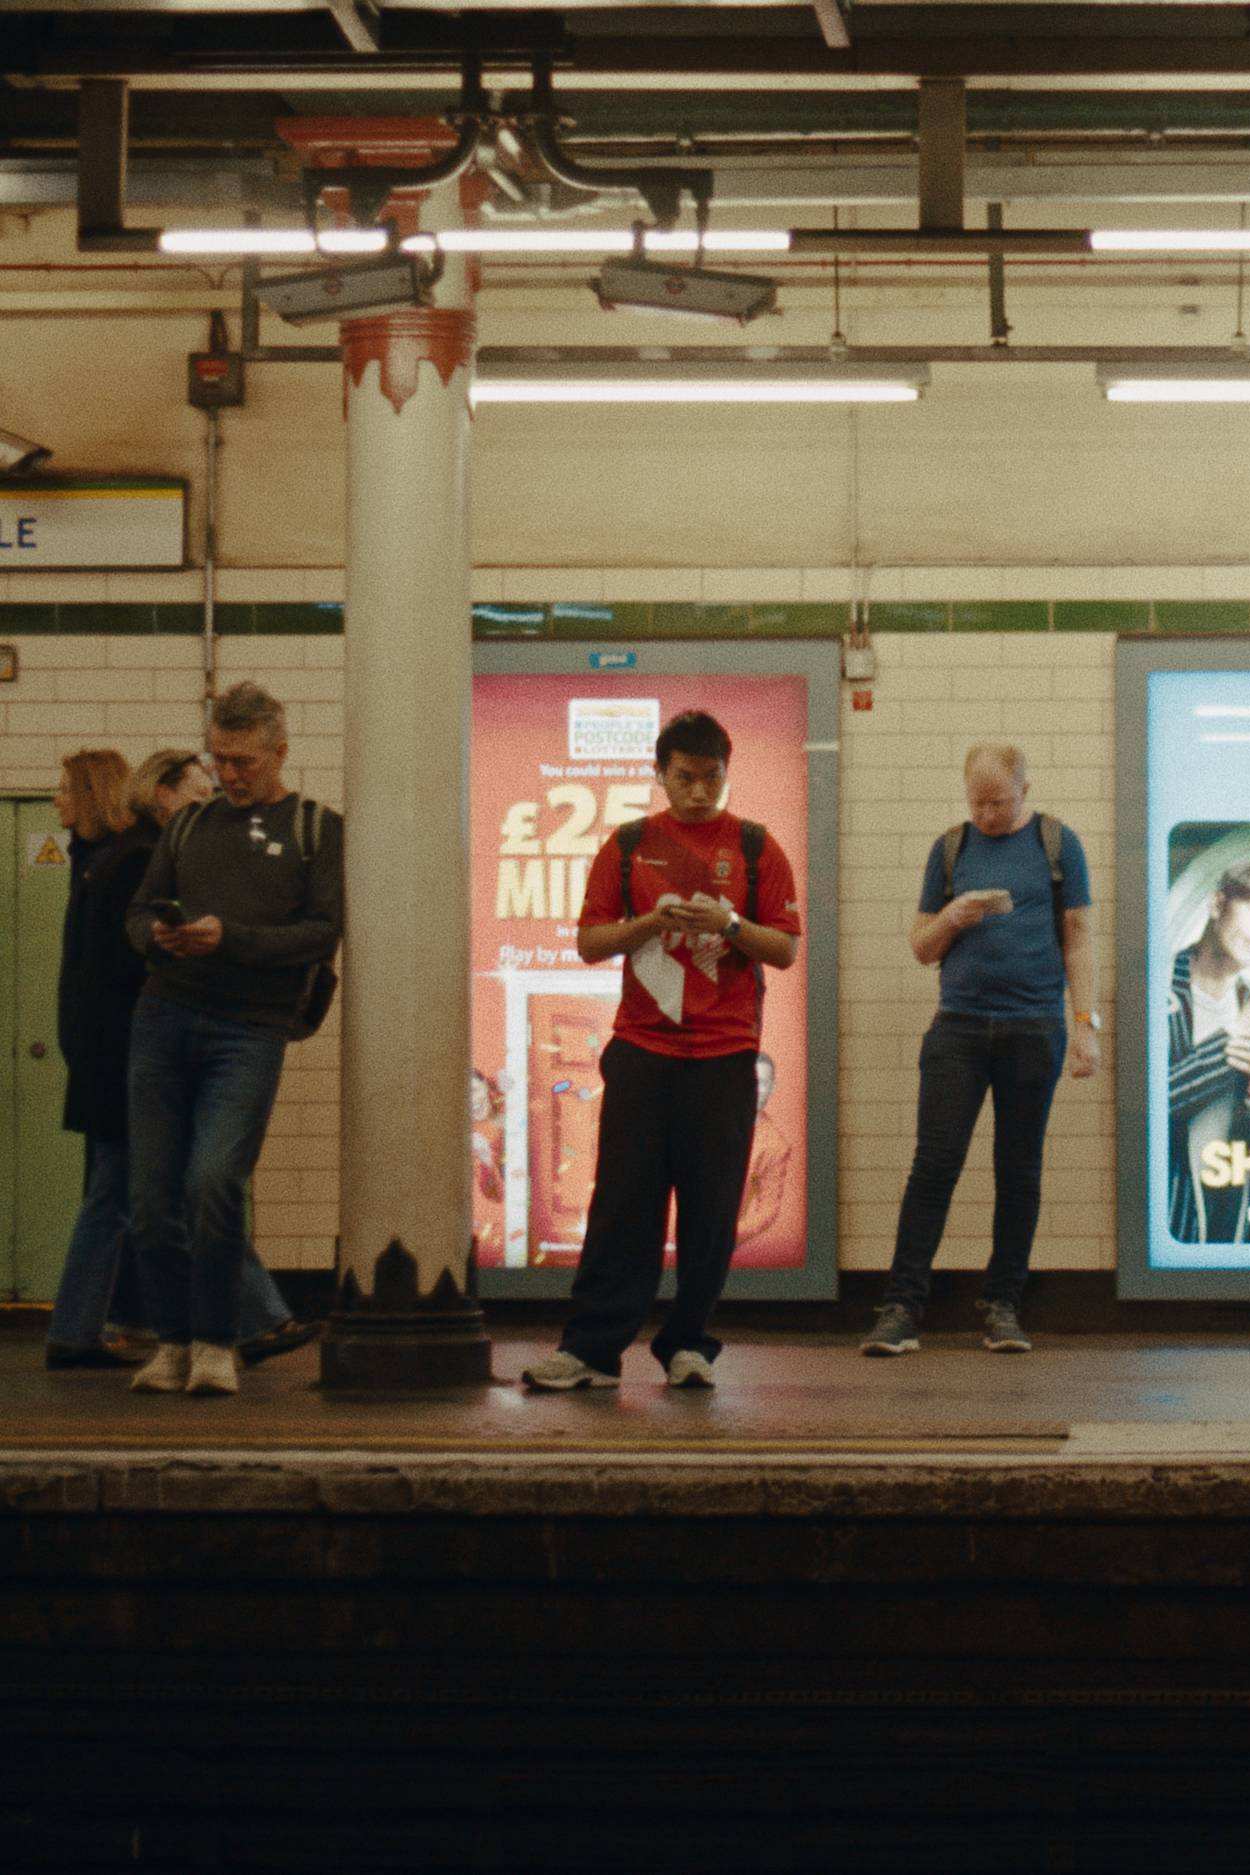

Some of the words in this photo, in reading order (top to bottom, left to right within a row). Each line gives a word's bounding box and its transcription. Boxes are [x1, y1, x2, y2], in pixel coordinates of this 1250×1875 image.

[574, 730, 653, 744] POSTCODE
[540, 763, 564, 777] You
[565, 763, 600, 777] could
[602, 764, 626, 777] win
[628, 767, 636, 777] a
[500, 946, 533, 966] Play
[537, 945, 558, 966] by
